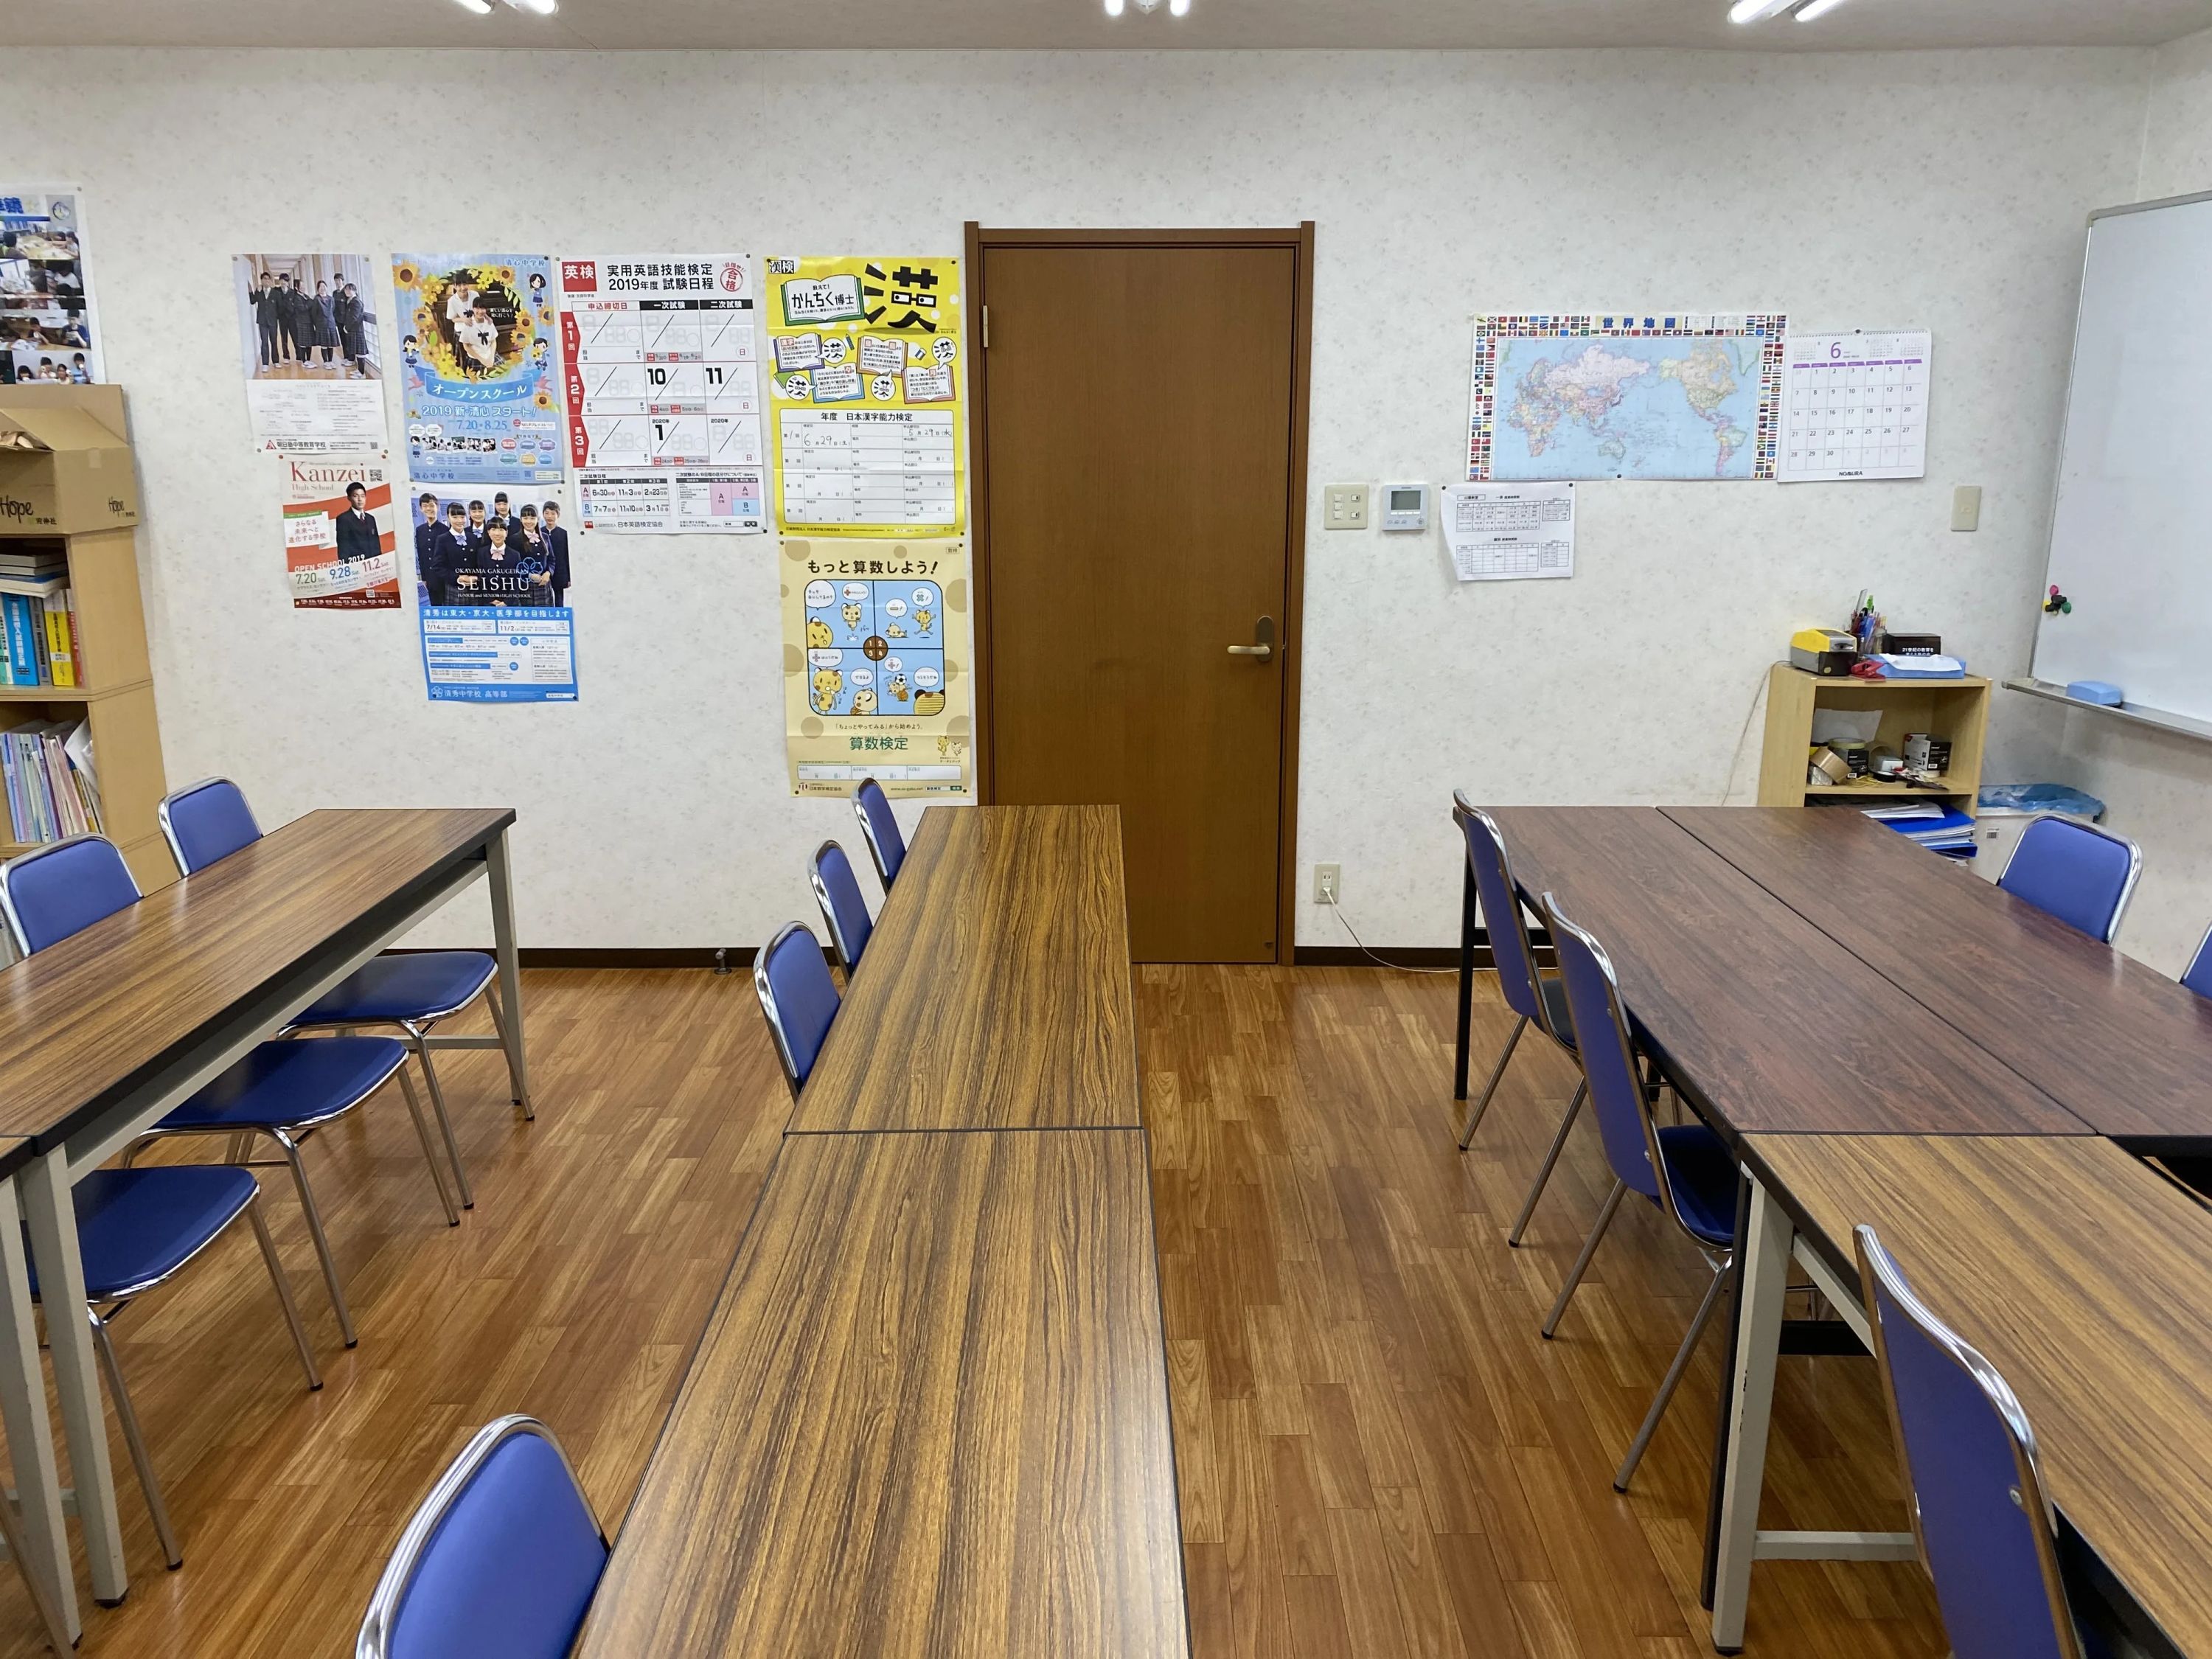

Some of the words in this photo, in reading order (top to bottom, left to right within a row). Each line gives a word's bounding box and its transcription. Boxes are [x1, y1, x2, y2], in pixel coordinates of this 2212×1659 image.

[564, 264, 594, 279] 英検
[607, 263, 713, 277] 実用英語技能検定
[768, 260, 795, 274] 漢検
[609, 278, 659, 291] 2019年度
[663, 278, 714, 291] 試験日程
[725, 268, 738, 291] 合格
[588, 302, 627, 310] 申込締切日
[653, 300, 686, 310] 一次試験
[710, 300, 742, 309] 二次試験
[791, 291, 855, 309] かんちく博士
[1601, 316, 1677, 329] 世界地図
[1830, 341, 1842, 359] 6
[647, 368, 666, 385] 10
[706, 367, 723, 384] 11
[433, 383, 527, 400] オープンスクール
[422, 406, 452, 417] 2019
[493, 406, 537, 417] スタート!
[821, 412, 838, 421] 年度
[846, 413, 913, 422] 日本漢字能力検定
[456, 420, 479, 431] 7.20
[484, 420, 507, 431] 8.25
[655, 424, 664, 441] 1
[289, 461, 367, 483] Kanzei
[292, 483, 309, 491] High
[311, 483, 333, 491] School
[0, 495, 34, 524] Hope
[108, 495, 125, 518] Hope
[296, 519, 316, 527] さらなる
[294, 564, 316, 572] OPEN
[317, 558, 347, 571] SCHOOL
[348, 554, 366, 565] 2019
[362, 557, 381, 572] 11.2
[807, 560, 939, 575] もっと算数しよう!
[296, 572, 317, 585] 7.20
[330, 566, 351, 580] 9.28
[456, 577, 530, 591] SEISHU
[423, 608, 569, 618] 清秀は東大・京大・医学部を目指します
[444, 689, 481, 698] 清秀中学校
[484, 690, 508, 698] 高等部
[849, 736, 908, 751] 算数検定
